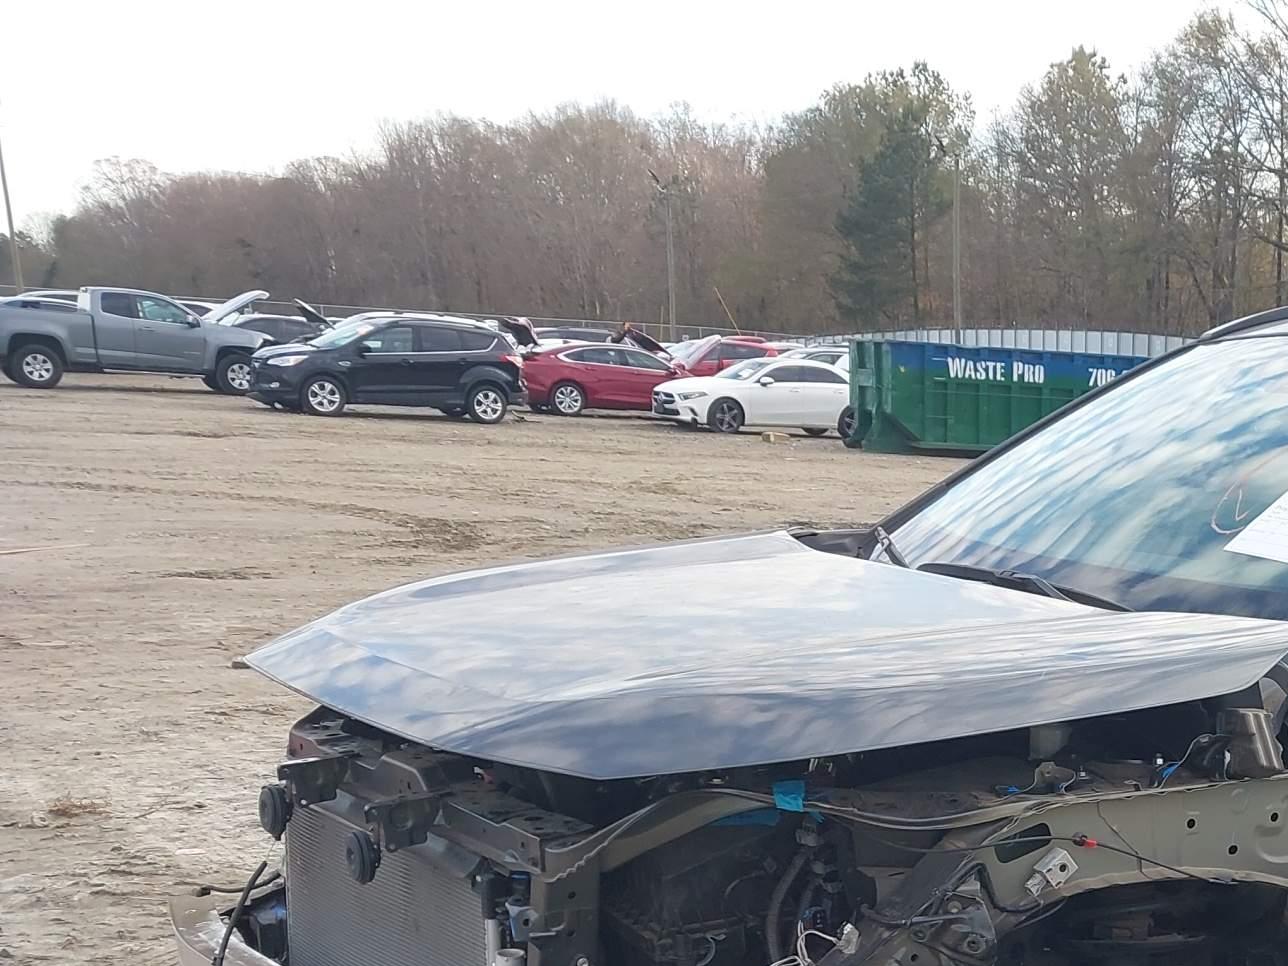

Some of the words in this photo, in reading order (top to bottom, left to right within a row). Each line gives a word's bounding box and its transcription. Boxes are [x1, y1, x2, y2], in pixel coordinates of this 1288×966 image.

[947, 357, 1005, 381] WASTE
[1013, 361, 1045, 384] PRO
[1088, 368, 1128, 387] 706
